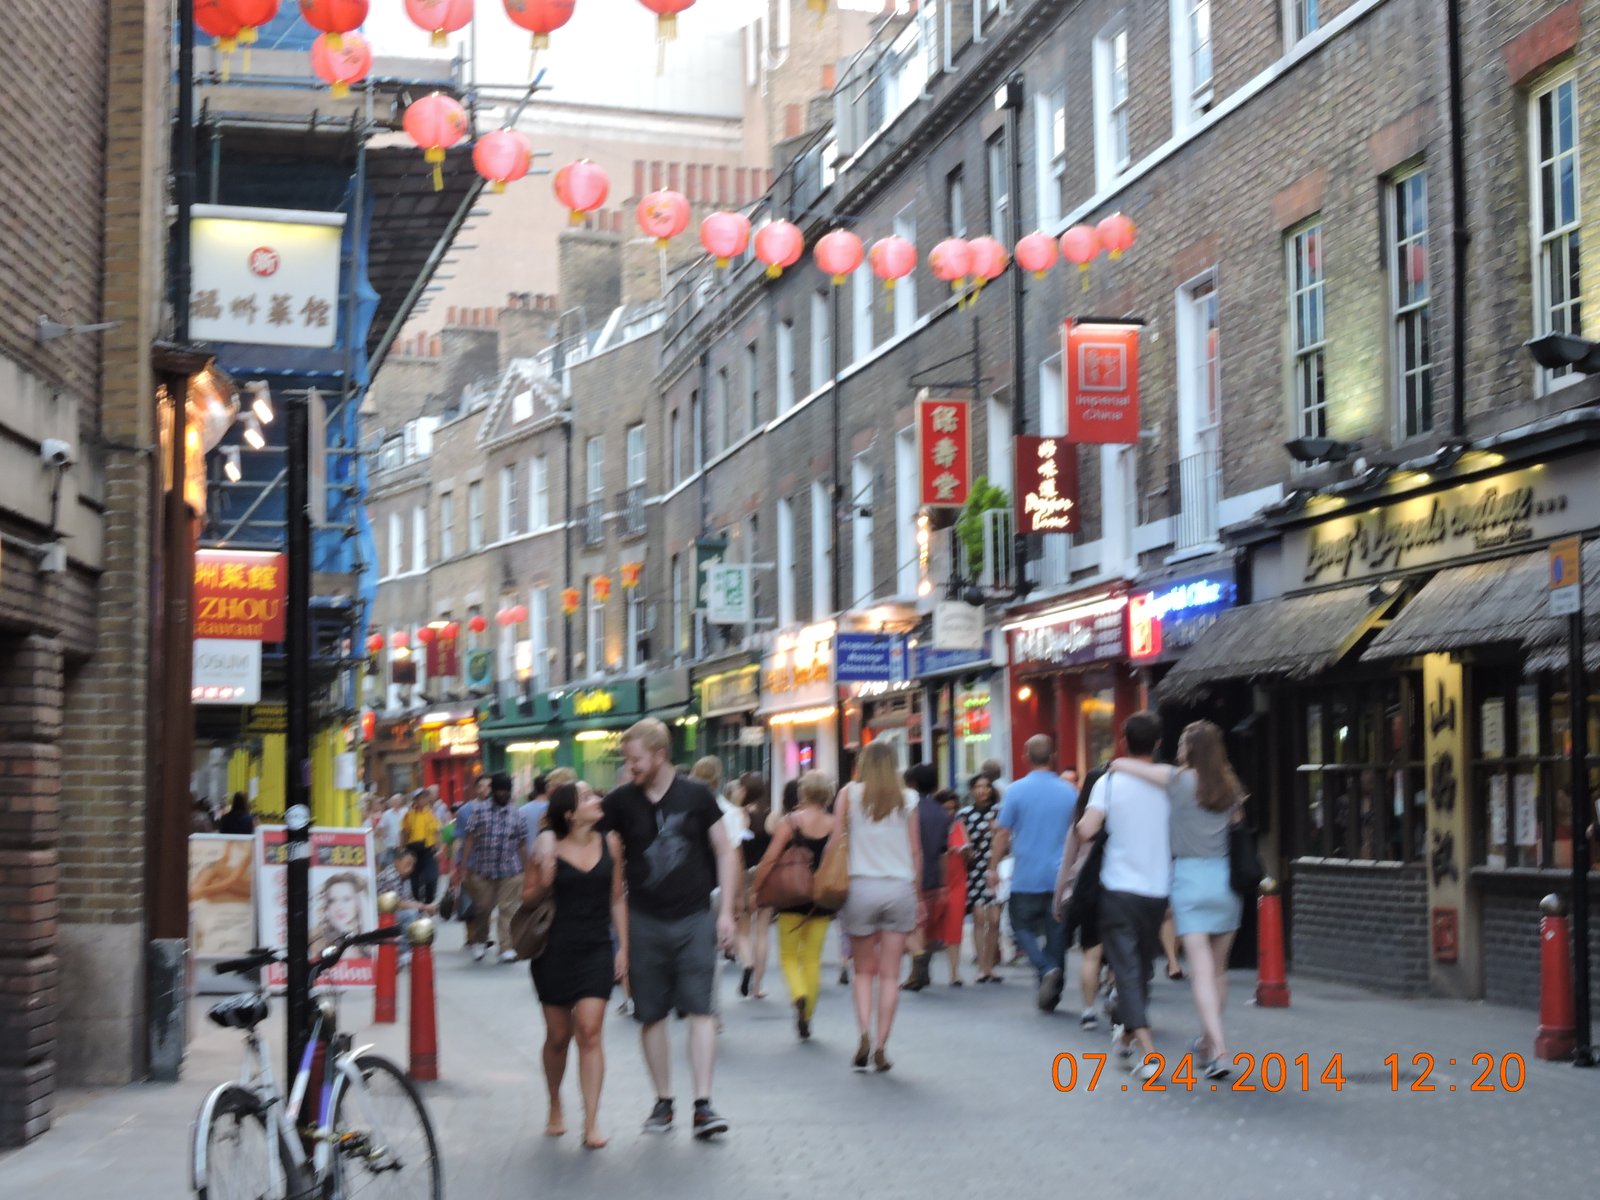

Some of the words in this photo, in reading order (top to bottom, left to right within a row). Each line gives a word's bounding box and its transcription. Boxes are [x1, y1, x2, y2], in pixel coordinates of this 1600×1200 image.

[1076, 395, 1130, 406] Imperial
[1083, 408, 1123, 420] China
[198, 596, 279, 621] ZHOU
